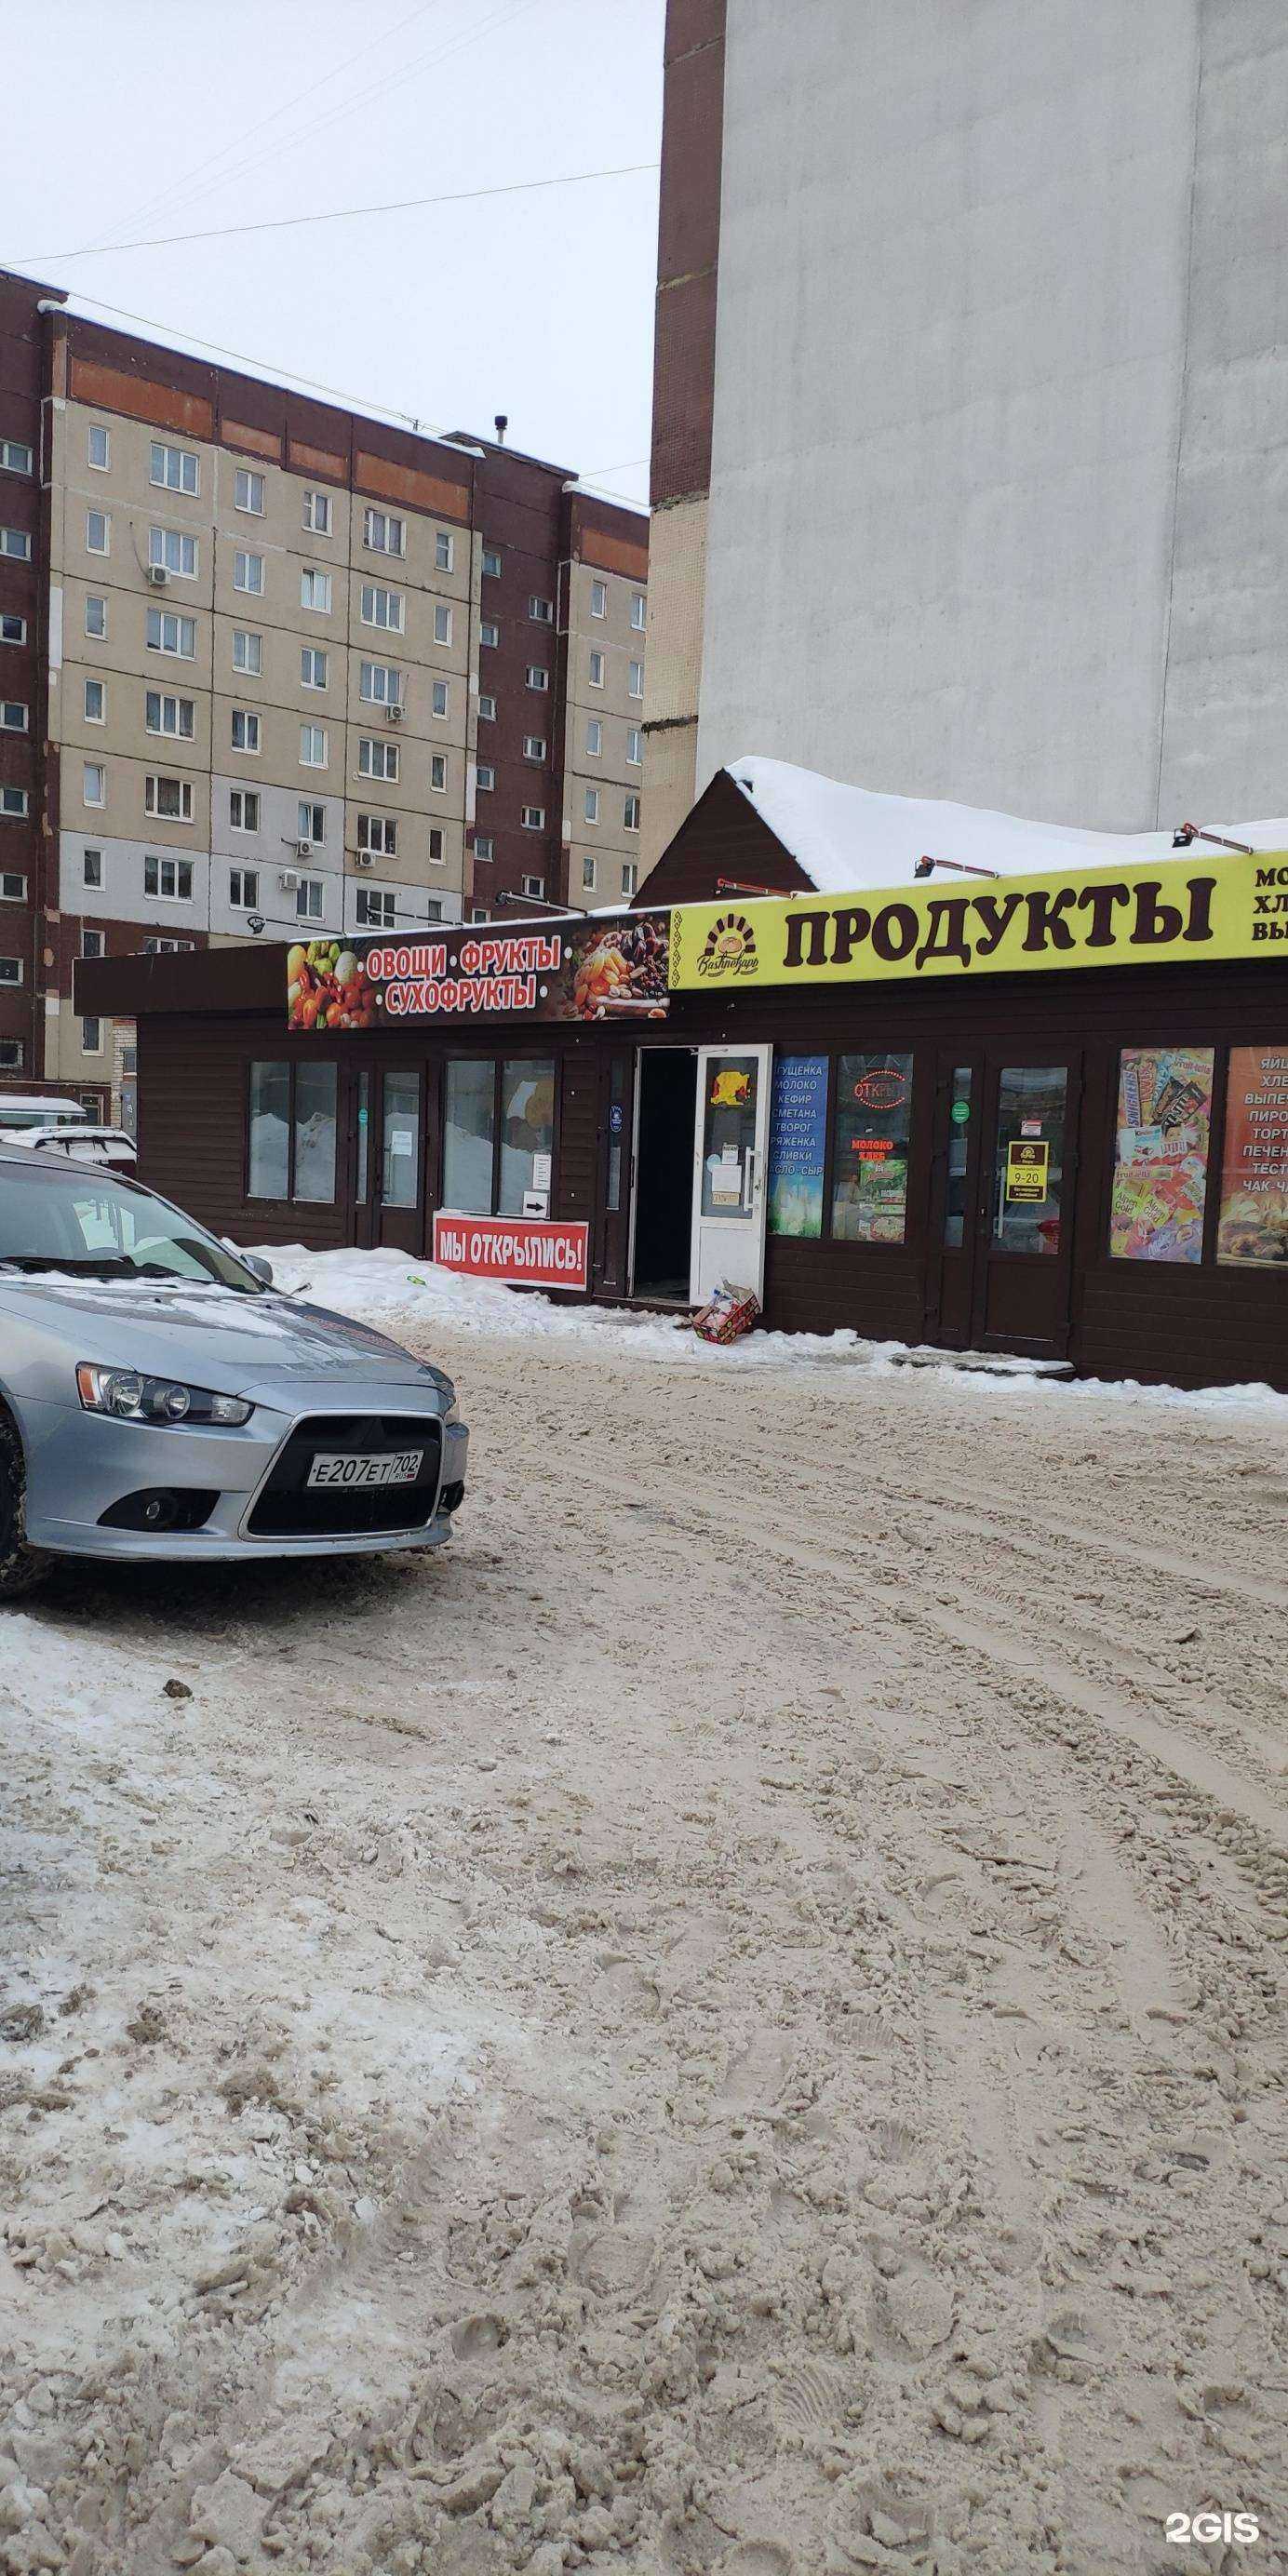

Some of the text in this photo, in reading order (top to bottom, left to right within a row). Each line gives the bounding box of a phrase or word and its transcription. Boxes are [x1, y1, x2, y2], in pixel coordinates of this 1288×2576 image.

[783, 878, 1217, 971] ПРОДУКТЫ
[368, 936, 560, 980] ОВОЩИ ФРУКТЫ
[386, 975, 535, 1014] СУХОФРУКТЫ
[778, 1094, 812, 1105] КЕФИР
[775, 1122, 812, 1133] ТВОРОГ
[852, 1140, 893, 1150] МОЛОКО
[773, 1151, 812, 1161] СЛИВКИ
[1014, 1173, 1040, 1183] 9-20
[440, 1231, 583, 1271] МЫ ОТКРЫЛИСЬ!
[394, 1455, 419, 1473] 702
